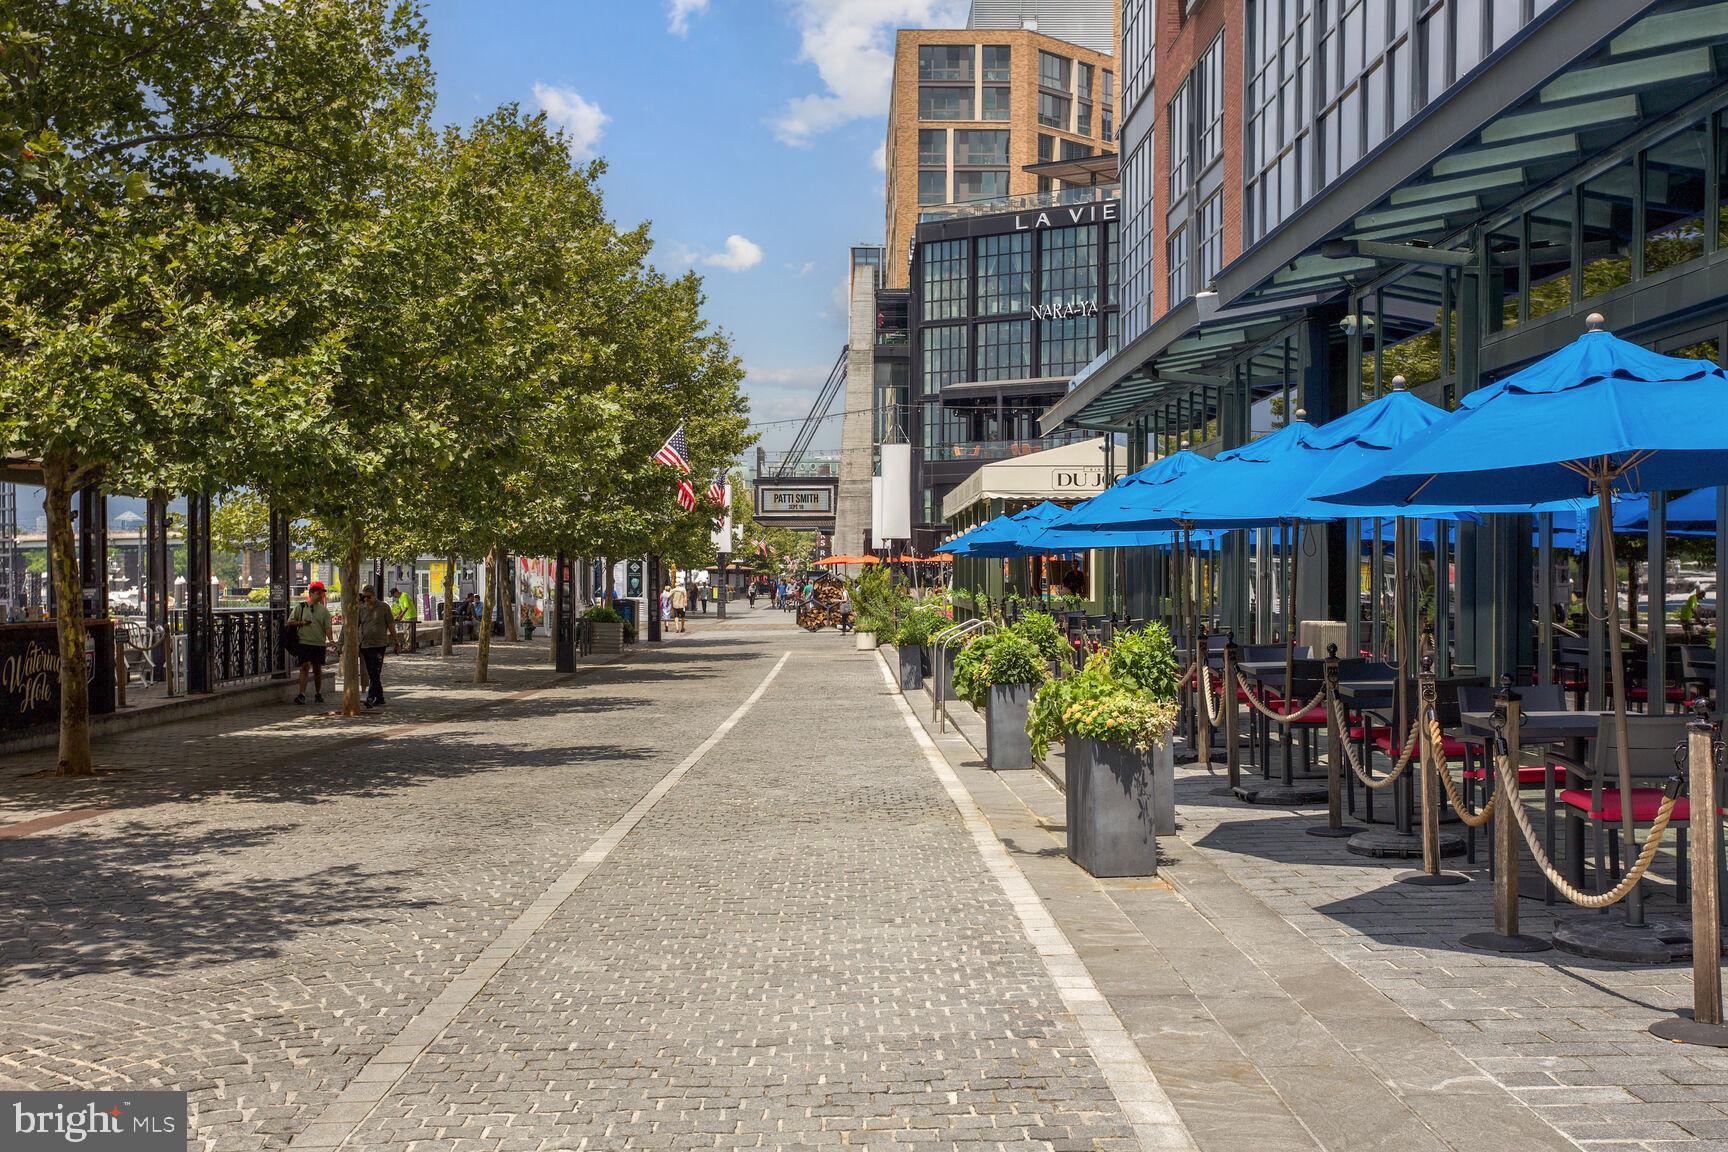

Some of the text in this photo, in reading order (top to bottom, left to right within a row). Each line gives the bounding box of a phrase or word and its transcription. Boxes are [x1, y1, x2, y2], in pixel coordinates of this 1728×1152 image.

[1015, 203, 1117, 230] LA VIE
[1031, 301, 1098, 321] NARA-YA
[1057, 473, 1087, 487] DU
[774, 493, 819, 504] PATTI SMITH
[19, 672, 51, 713] Hole
